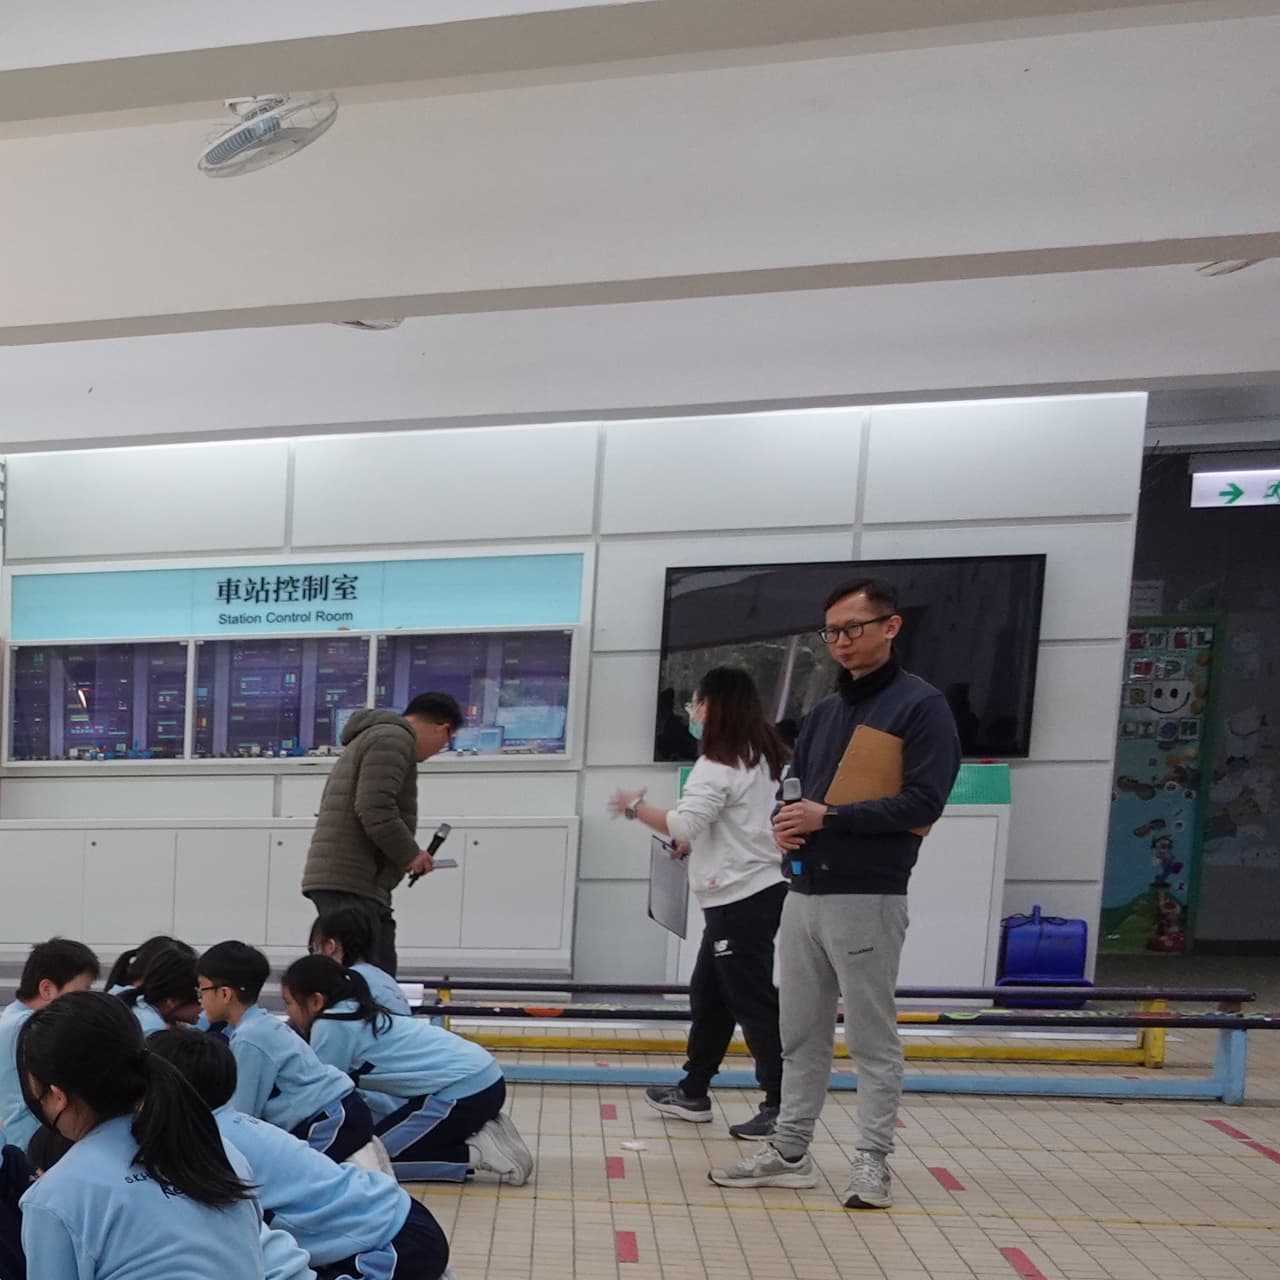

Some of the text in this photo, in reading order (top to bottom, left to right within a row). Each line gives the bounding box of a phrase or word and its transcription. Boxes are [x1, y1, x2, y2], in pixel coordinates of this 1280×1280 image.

[215, 574, 359, 605] 車站控制室
[218, 610, 354, 625] Station Control Room
